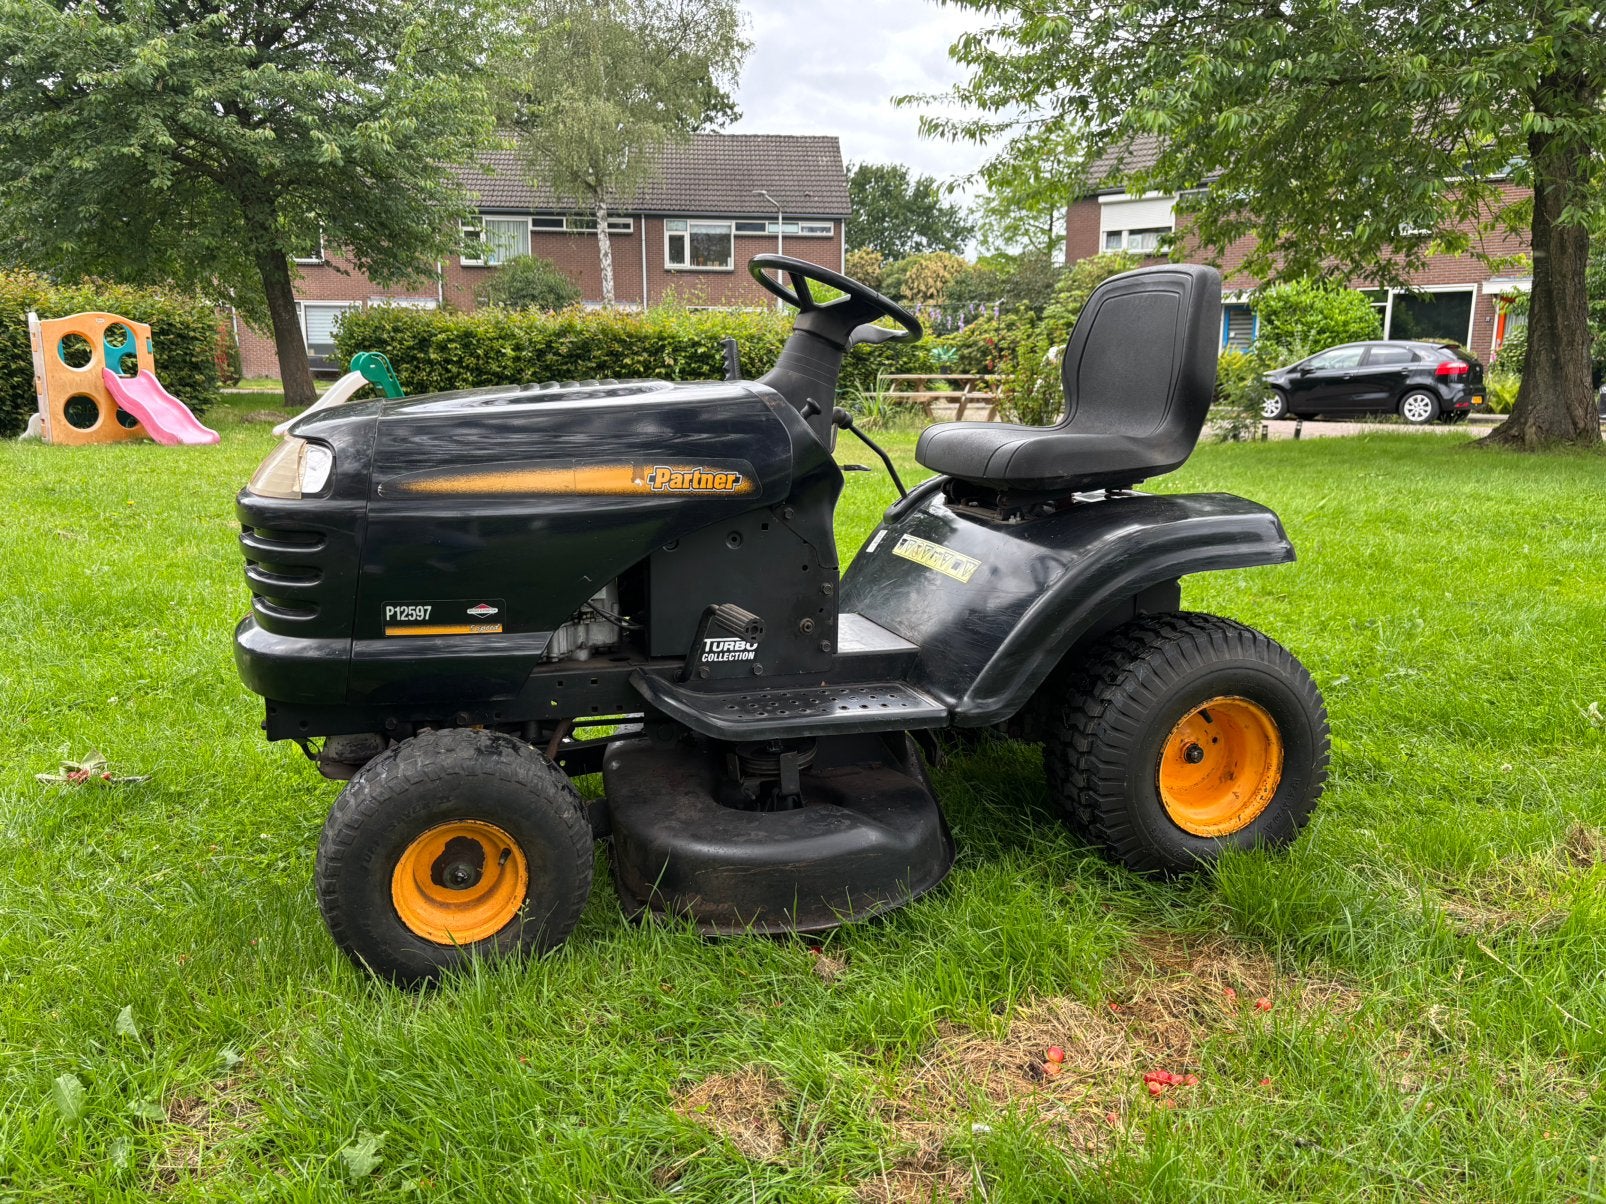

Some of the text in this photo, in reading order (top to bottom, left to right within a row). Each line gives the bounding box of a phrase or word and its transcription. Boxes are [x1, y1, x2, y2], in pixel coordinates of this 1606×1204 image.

[653, 467, 738, 491] Partner
[385, 605, 432, 621] P12597
[701, 651, 755, 662] COLLECTION
